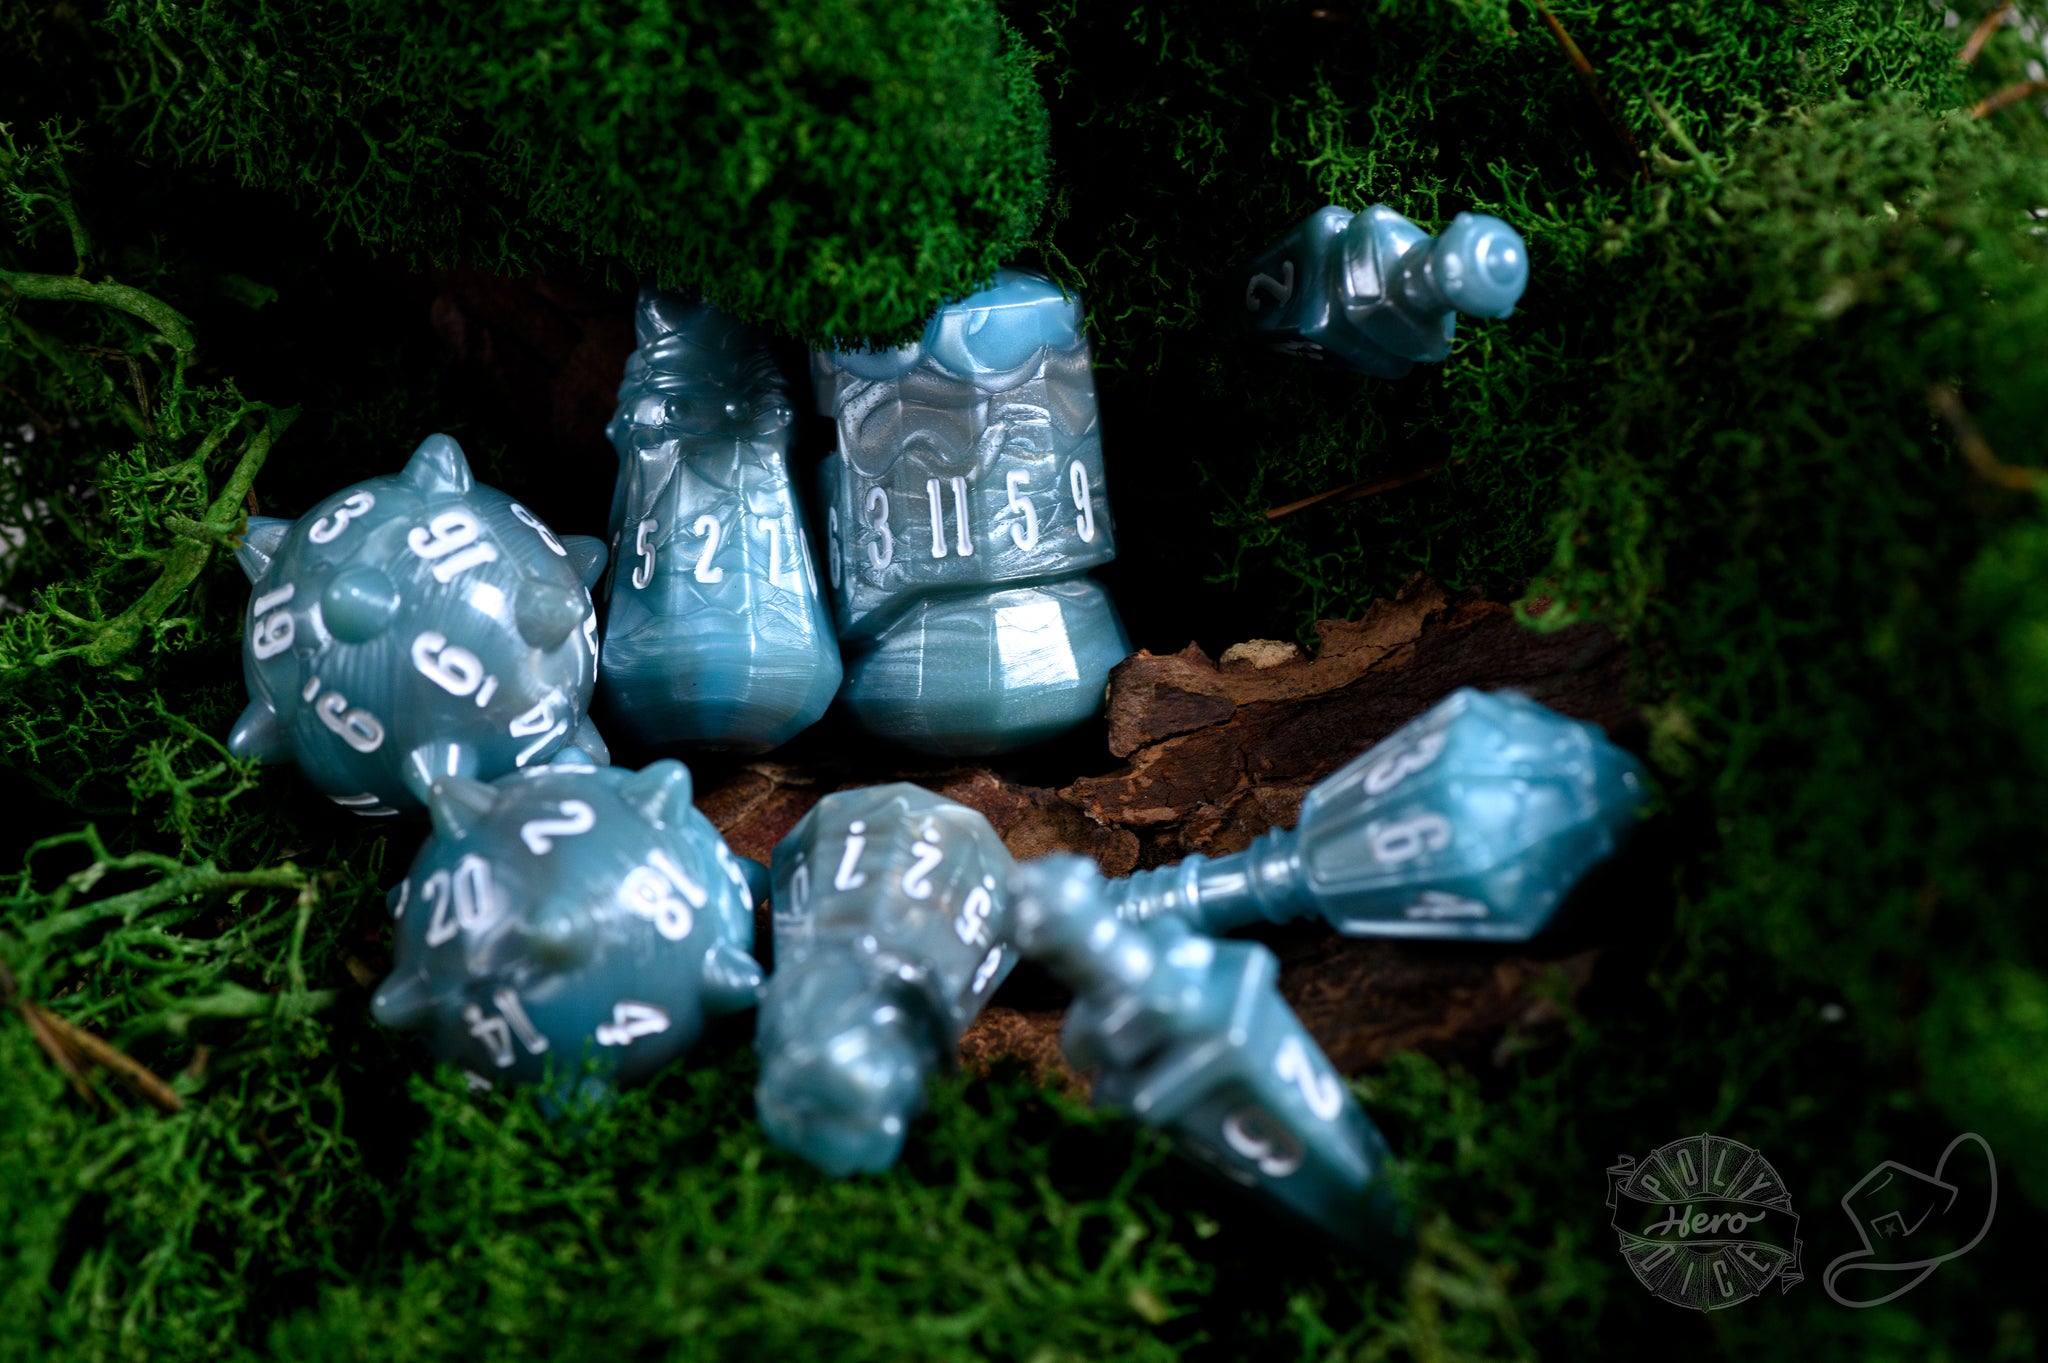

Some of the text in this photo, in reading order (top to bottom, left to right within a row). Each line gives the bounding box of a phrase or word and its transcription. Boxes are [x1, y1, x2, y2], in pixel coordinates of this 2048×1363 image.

[1247, 261, 1294, 312] 2
[309, 491, 375, 543] 3
[865, 486, 893, 569] 3
[927, 476, 974, 558] 11
[1007, 469, 1038, 551] 5
[1070, 460, 1094, 543] 9
[407, 506, 498, 583] 16
[632, 519, 658, 589] 5
[694, 515, 723, 583] 2
[253, 583, 295, 660] 19
[521, 801, 596, 855] 2
[421, 854, 494, 947] 20
[619, 848, 707, 940] 18
[902, 841, 943, 899] 2
[463, 990, 550, 1067] 14
[596, 1003, 670, 1046] 4
[1275, 1035, 1342, 1121] 2
